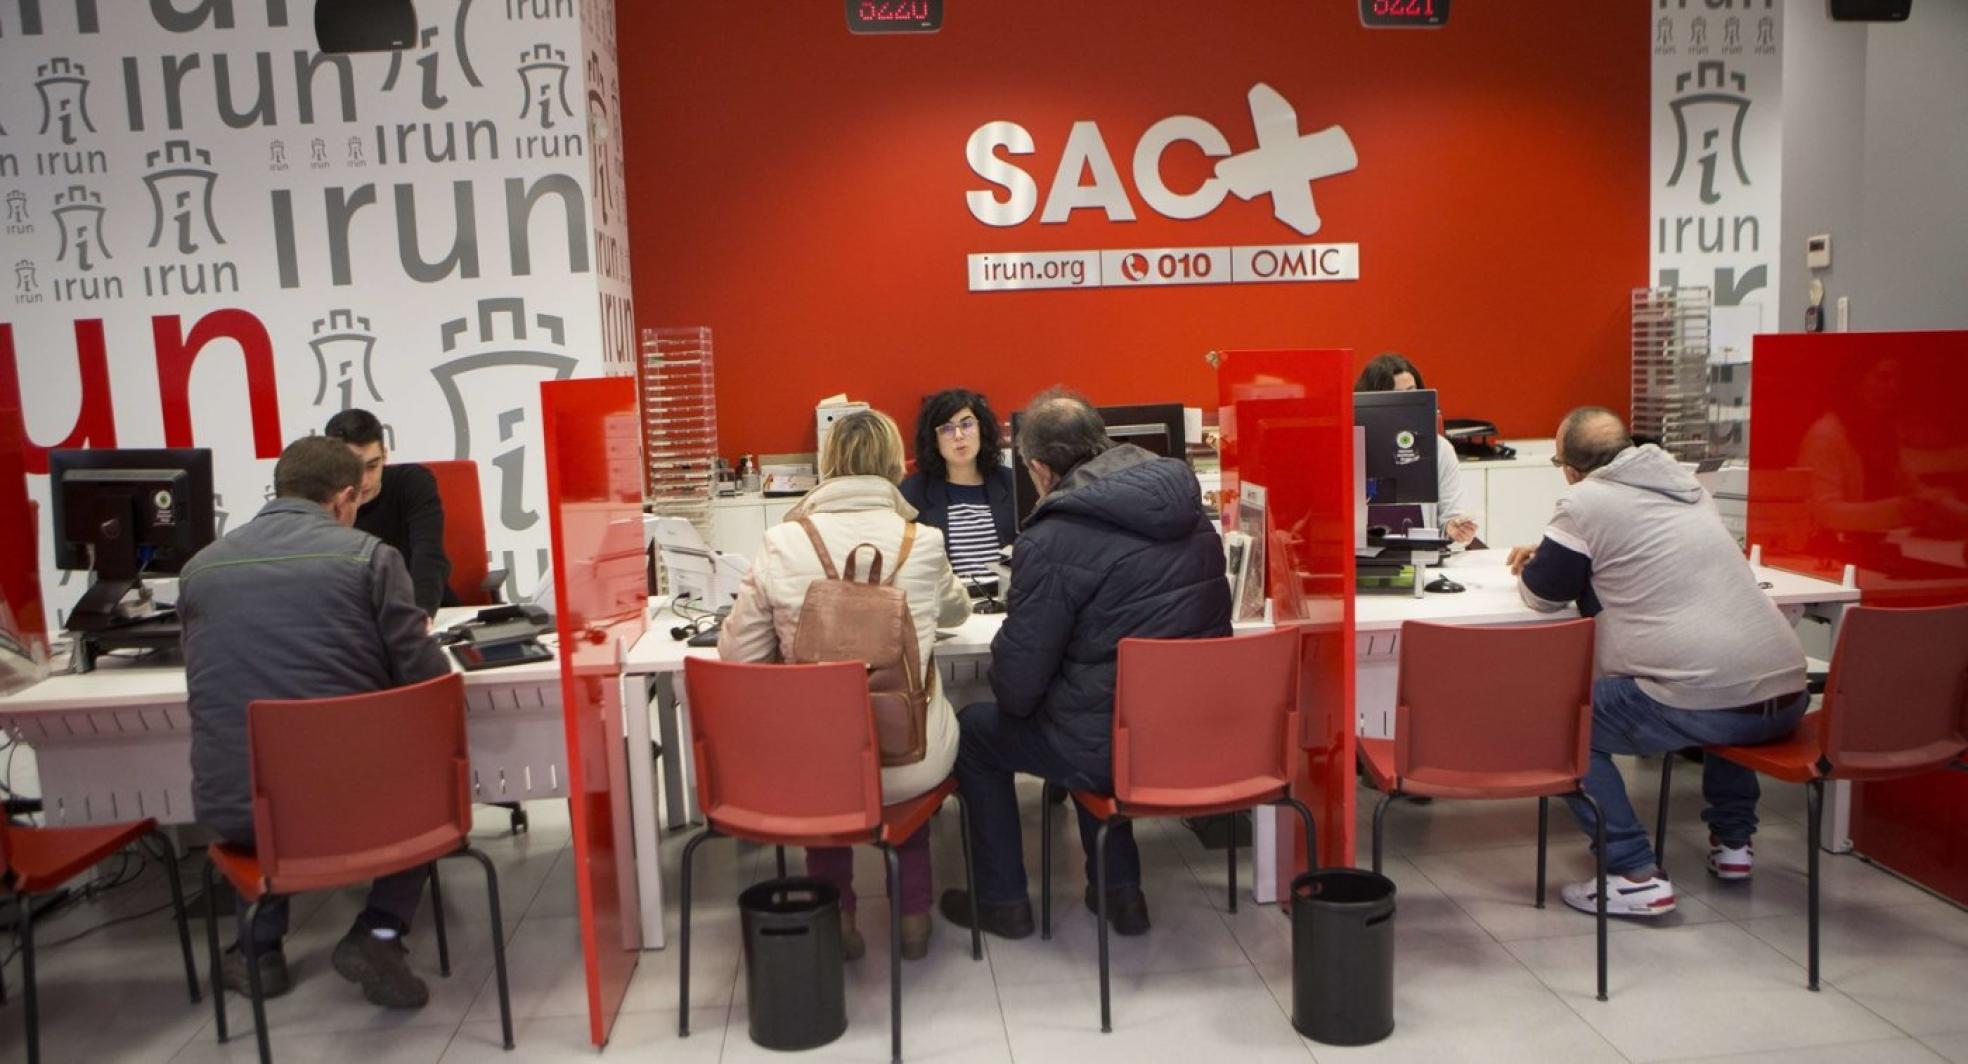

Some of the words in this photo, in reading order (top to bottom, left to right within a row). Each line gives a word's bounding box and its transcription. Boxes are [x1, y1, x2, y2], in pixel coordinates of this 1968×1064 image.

[122, 50, 357, 132] irun
[375, 119, 499, 165] irun
[515, 133, 583, 159] irun
[36, 150, 108, 176] irun
[270, 173, 590, 289] irun
[1658, 215, 1760, 254] irun
[144, 261, 240, 297] irun
[984, 256, 1085, 285] irun.org
[1158, 253, 1211, 278] 010
[1251, 249, 1341, 278] OMIC
[53, 274, 124, 302] irun
